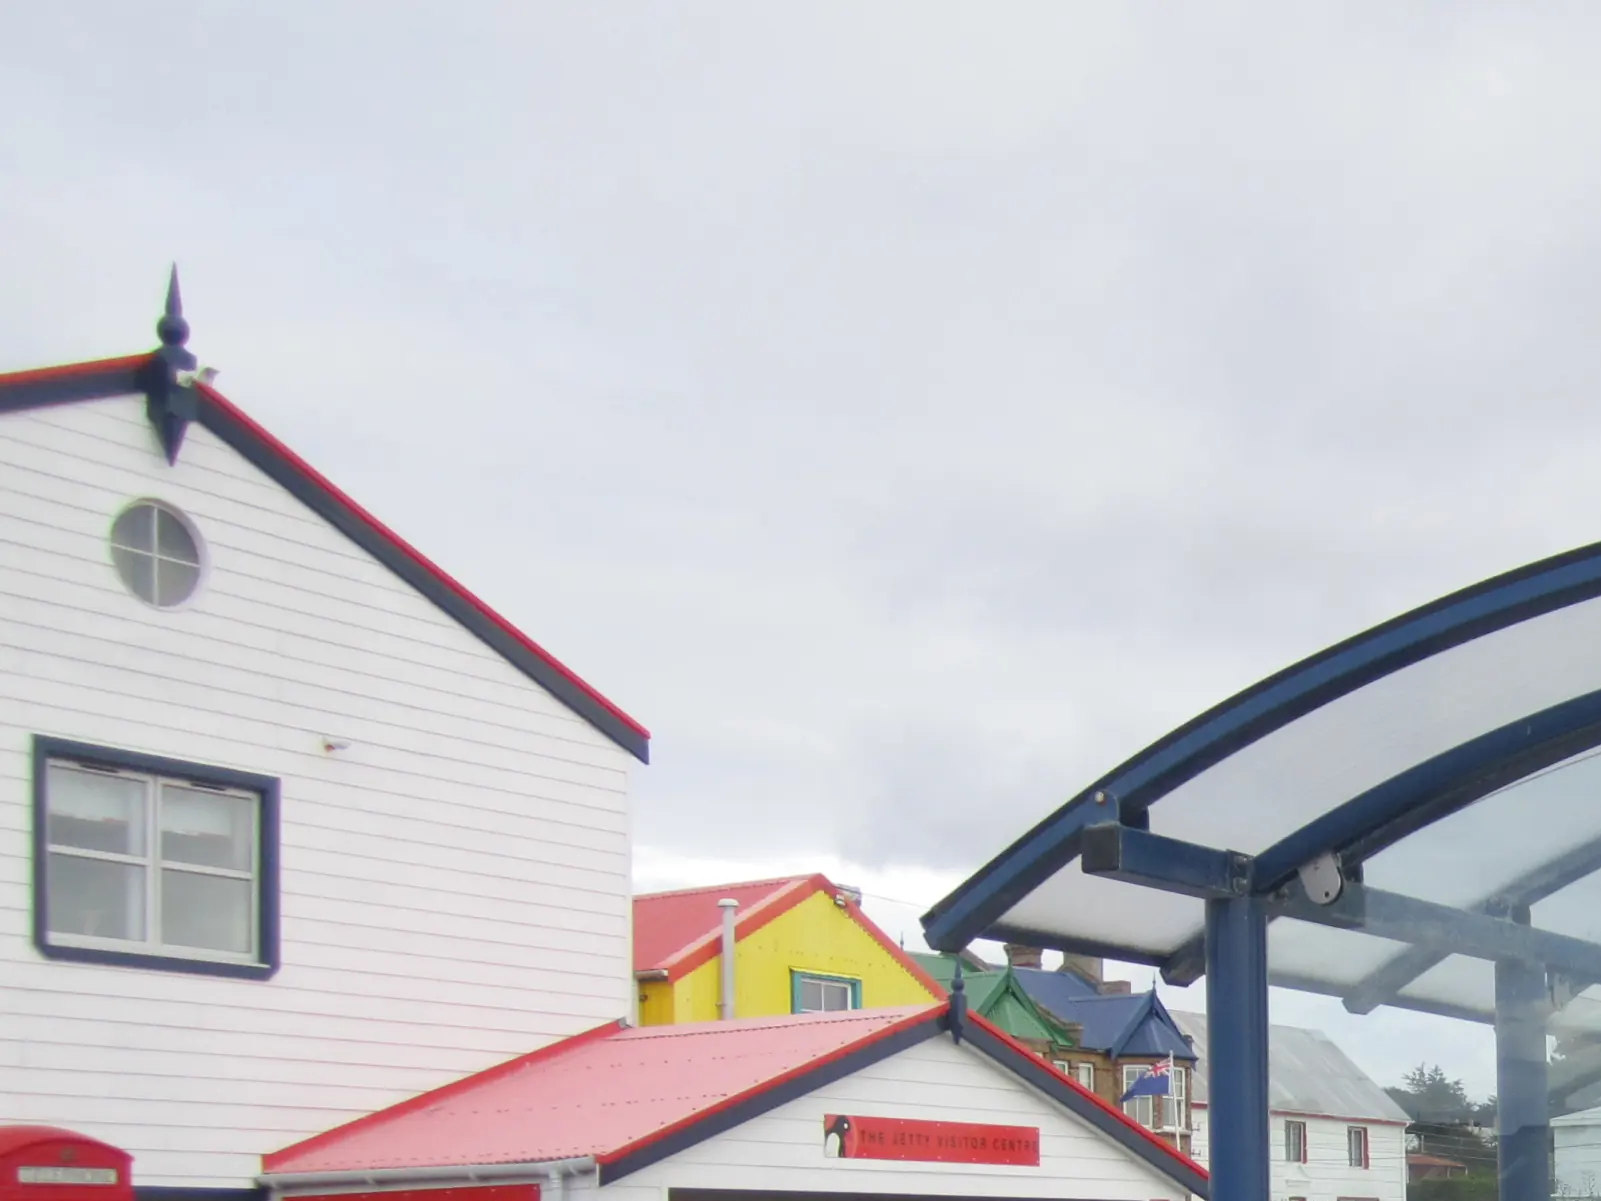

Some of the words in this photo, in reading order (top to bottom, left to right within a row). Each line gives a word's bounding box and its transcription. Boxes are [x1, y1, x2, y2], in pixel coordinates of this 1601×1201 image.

[860, 1130, 885, 1145] THE
[892, 1131, 931, 1147] JETTY
[936, 1134, 987, 1149] VISITOR
[992, 1137, 1038, 1153] CENTRE
